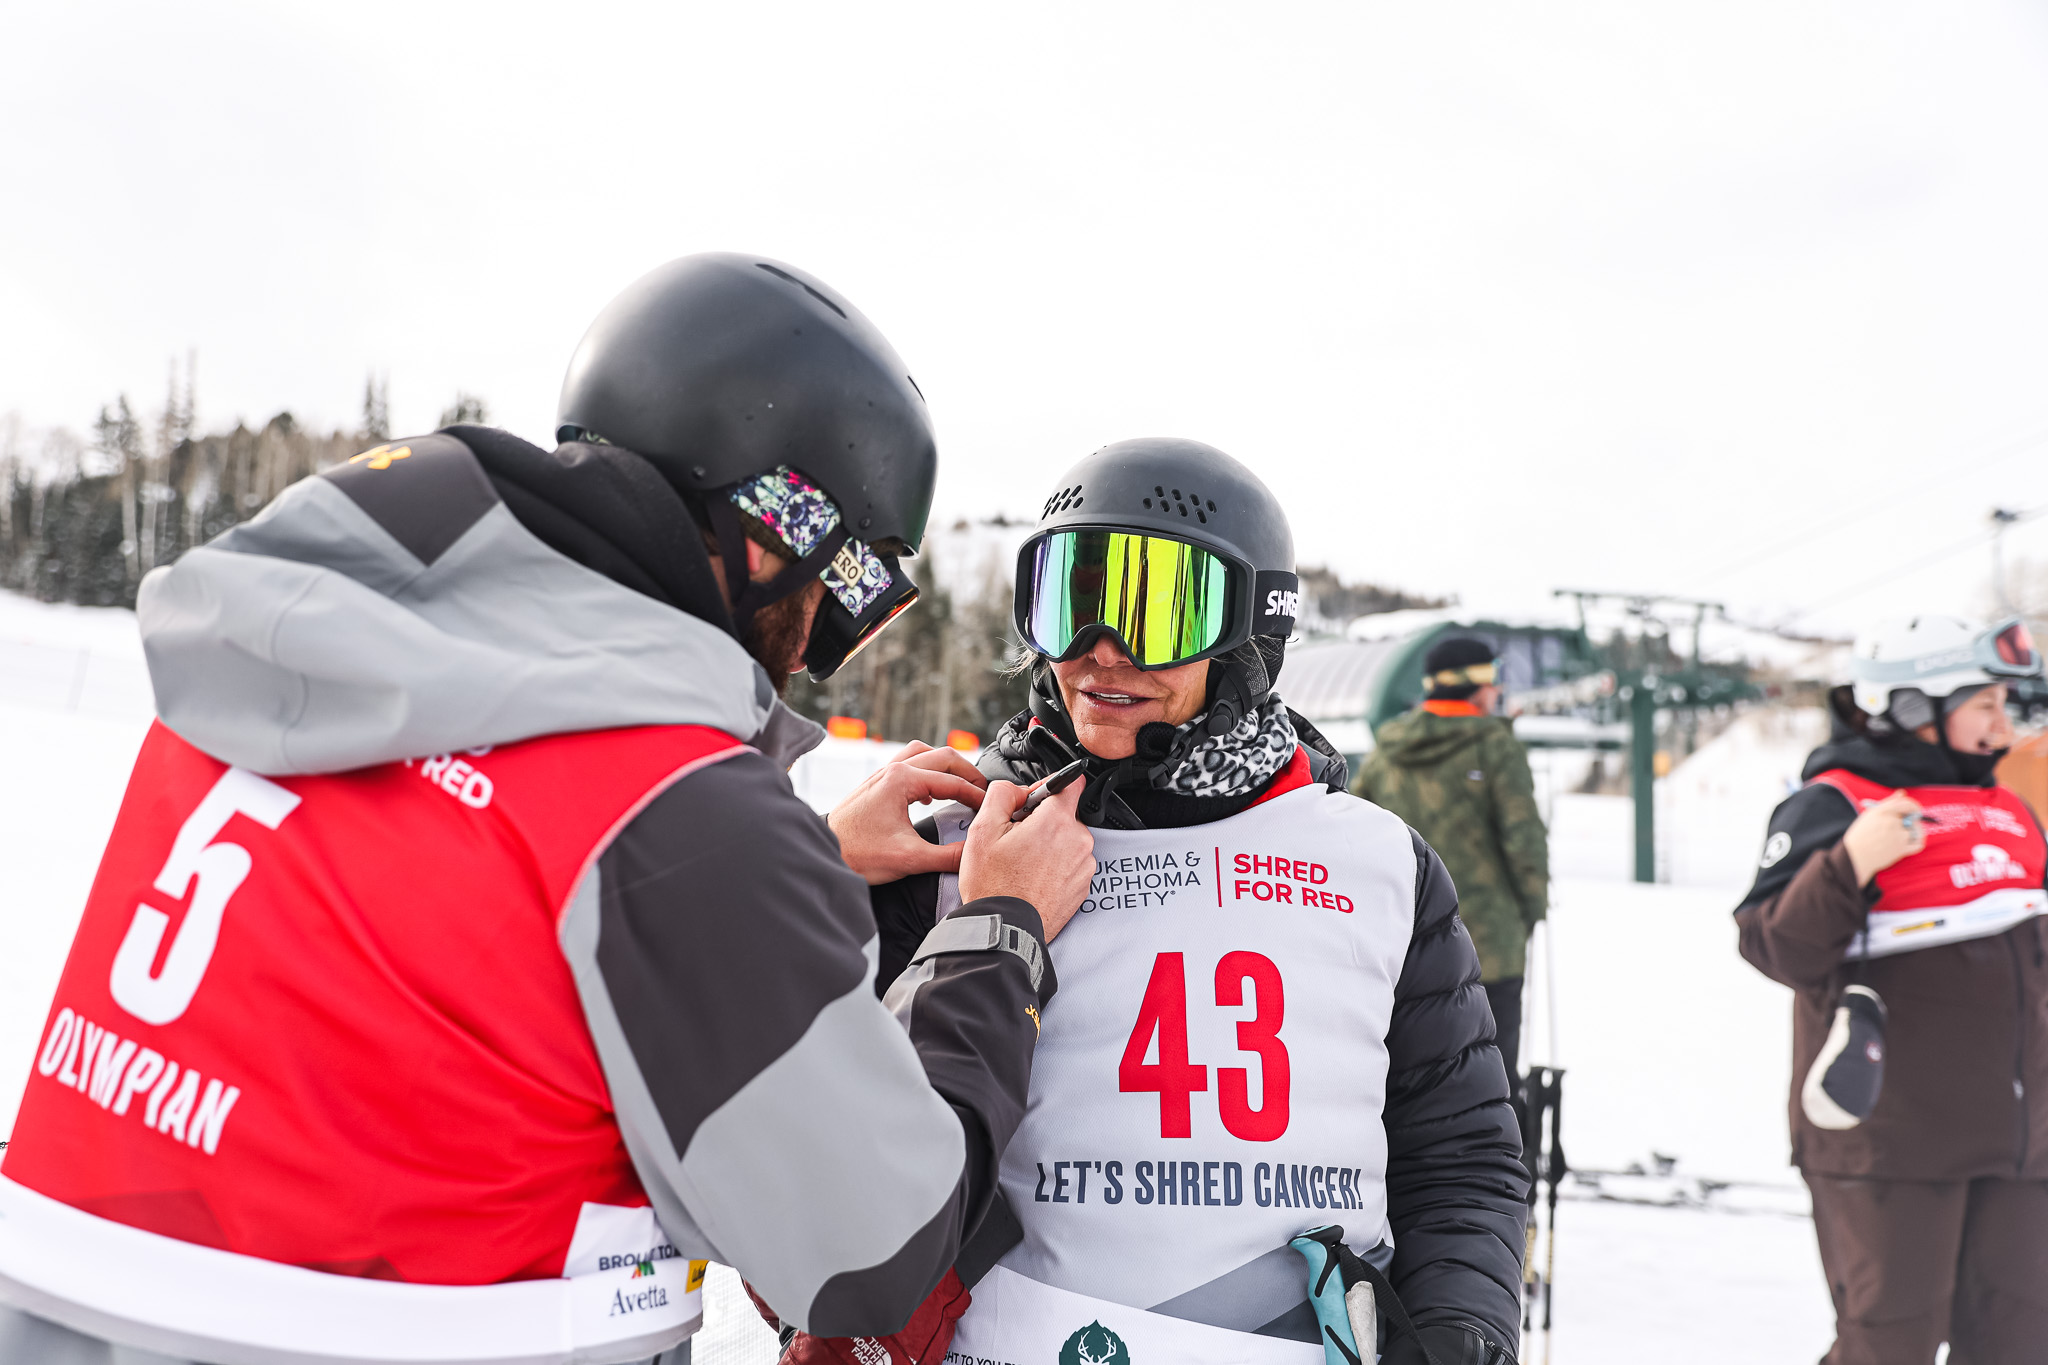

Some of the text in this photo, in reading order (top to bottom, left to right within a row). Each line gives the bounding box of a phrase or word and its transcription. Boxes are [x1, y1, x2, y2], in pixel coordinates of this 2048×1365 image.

[834, 549, 859, 580] IRO
[1264, 589, 1299, 619] SHRE
[420, 753, 494, 810] RED
[1093, 851, 1201, 876] UKEMIA &
[1233, 853, 1329, 885] SHRED
[109, 765, 303, 1026] 5
[1089, 870, 1202, 895] MPHOMA
[1234, 880, 1355, 914] FOR RED
[1079, 889, 1177, 914] OCIETY®
[1118, 950, 1291, 1142] 43
[37, 1006, 241, 1156] OLYMPIAN
[1034, 1160, 1364, 1210] LET'S SHRED CANCER!
[608, 1284, 670, 1317] Avetta
[868, 1336, 888, 1357] THE
[961, 1354, 974, 1365] TO
